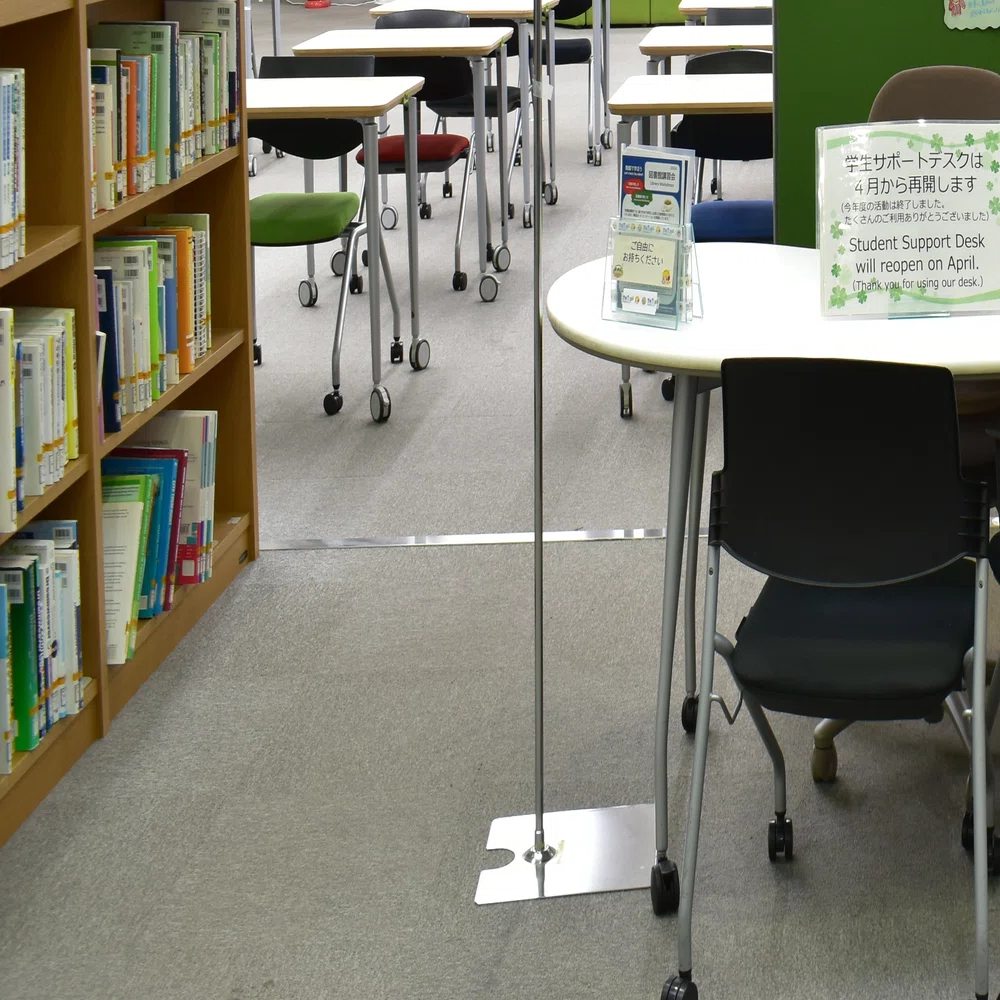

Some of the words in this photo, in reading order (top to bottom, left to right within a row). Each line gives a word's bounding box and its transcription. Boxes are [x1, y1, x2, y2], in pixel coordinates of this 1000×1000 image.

[845, 151, 984, 173] 学生サポートデスクは
[631, 241, 654, 252] ご自由に
[849, 235, 898, 252] Student
[902, 234, 951, 254] Support
[955, 233, 985, 249] Desk
[623, 252, 664, 265] お持ちください
[855, 258, 876, 274] will
[880, 260, 923, 275] reopen
[928, 260, 943, 271] on
[947, 256, 979, 273] April.
[852, 280, 882, 292] (Thank
[884, 282, 900, 291] you
[902, 278, 914, 289] for
[917, 278, 939, 291] using
[941, 279, 955, 288] our
[958, 275, 984, 288] desk.)
